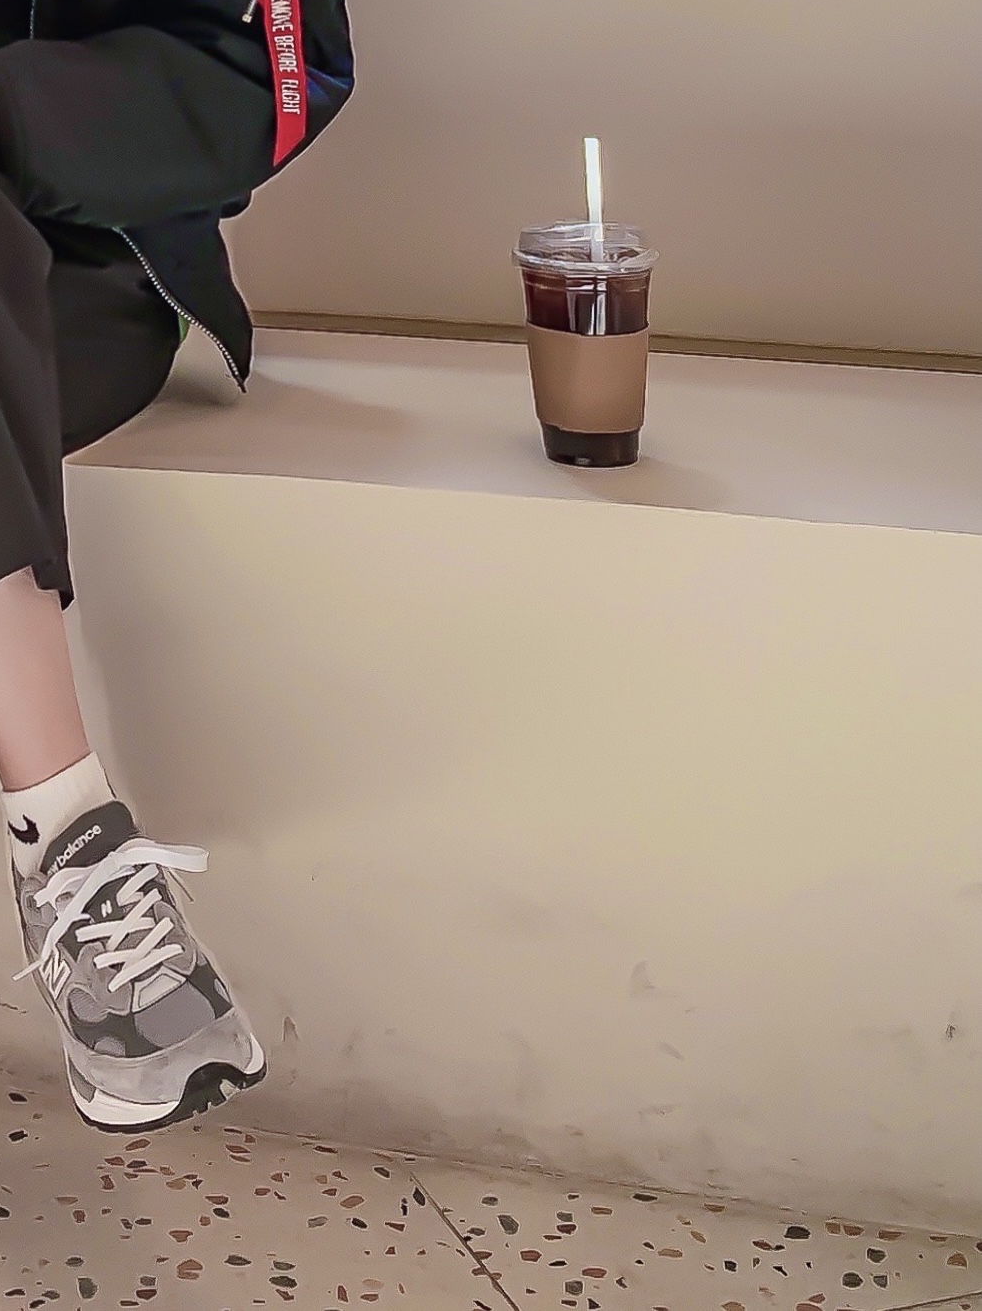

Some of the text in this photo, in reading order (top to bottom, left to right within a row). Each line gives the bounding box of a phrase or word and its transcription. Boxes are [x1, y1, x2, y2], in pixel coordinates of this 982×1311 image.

[274, 35, 298, 74] BEFORE
[281, 79, 301, 115] FLIGHT
[56, 824, 102, 867] balance
